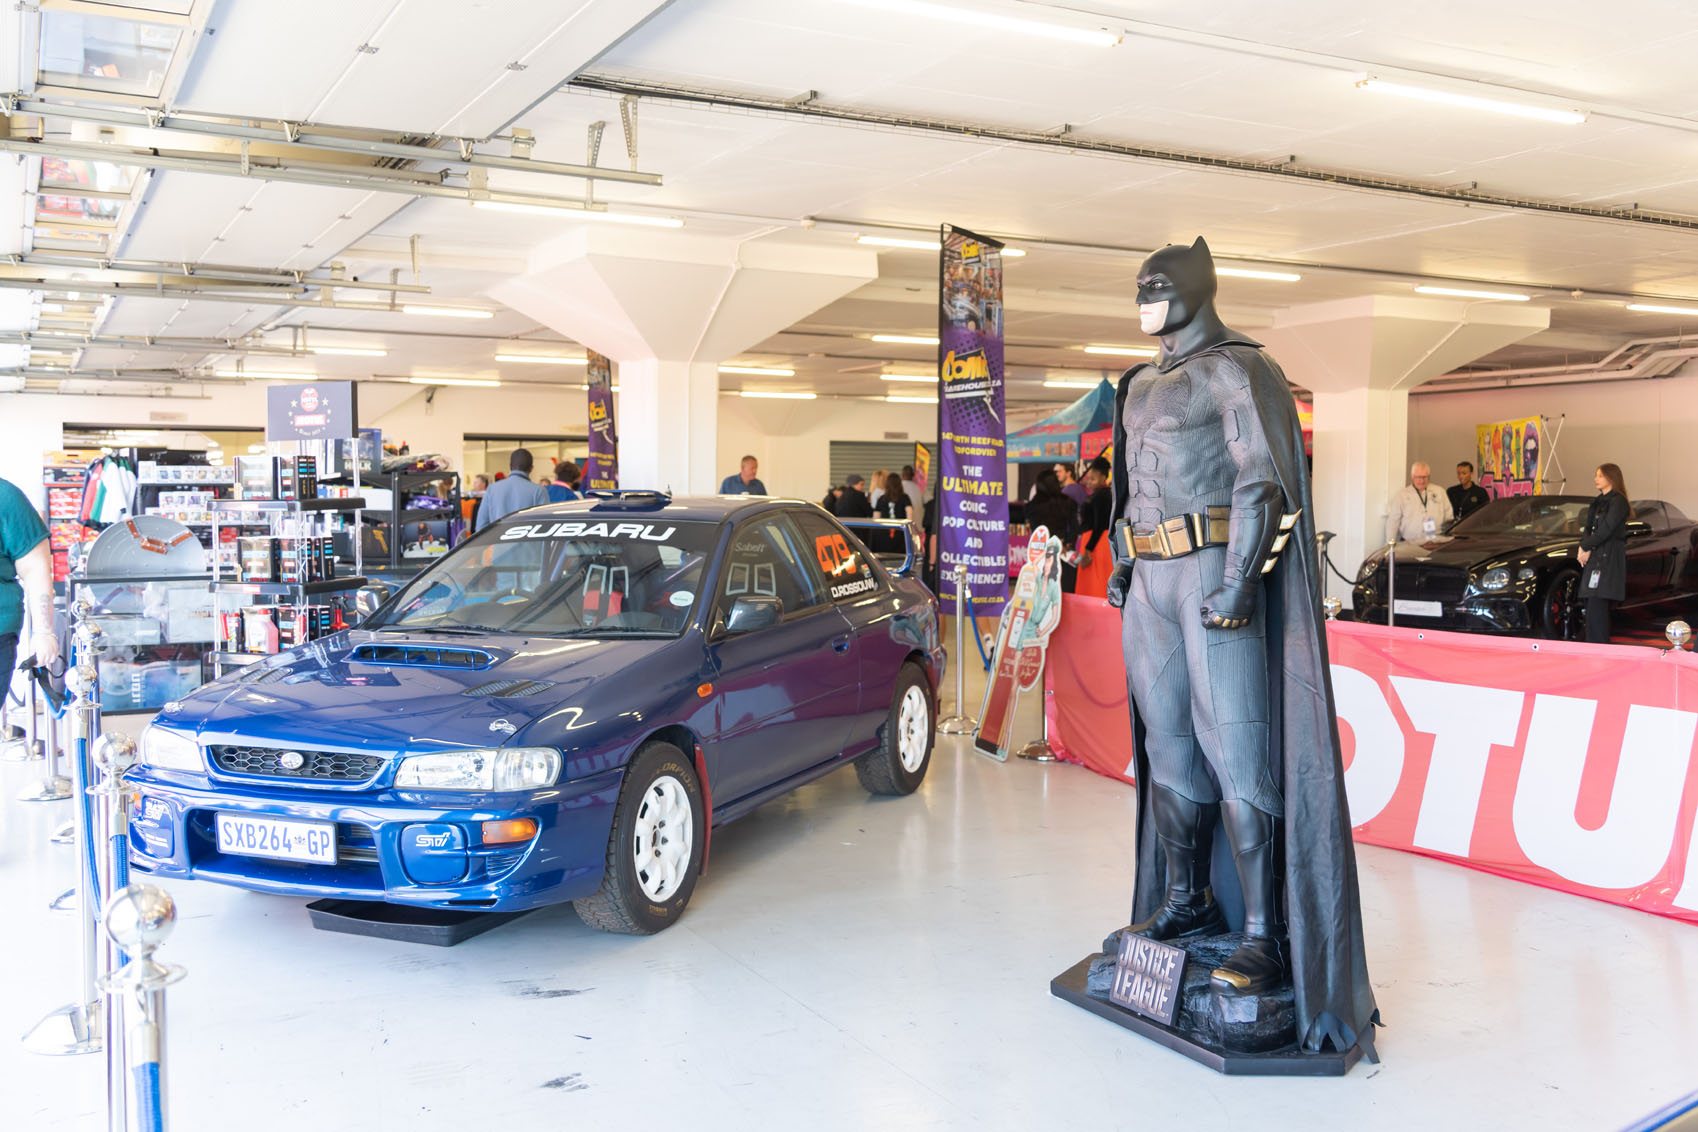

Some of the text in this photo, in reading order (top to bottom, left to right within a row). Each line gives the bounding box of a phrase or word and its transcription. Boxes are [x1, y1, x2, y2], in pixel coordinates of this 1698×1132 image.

[344, 460, 371, 470] HLK
[962, 465, 983, 477] THE
[942, 476, 1004, 496] ULTIMATE
[500, 522, 676, 541] SUBARU
[942, 516, 1006, 532] POP CLTURE
[223, 821, 330, 857] SXB264 GP
[1120, 935, 1179, 983] JUSTICE
[1113, 965, 1171, 1018] LEAGUE
